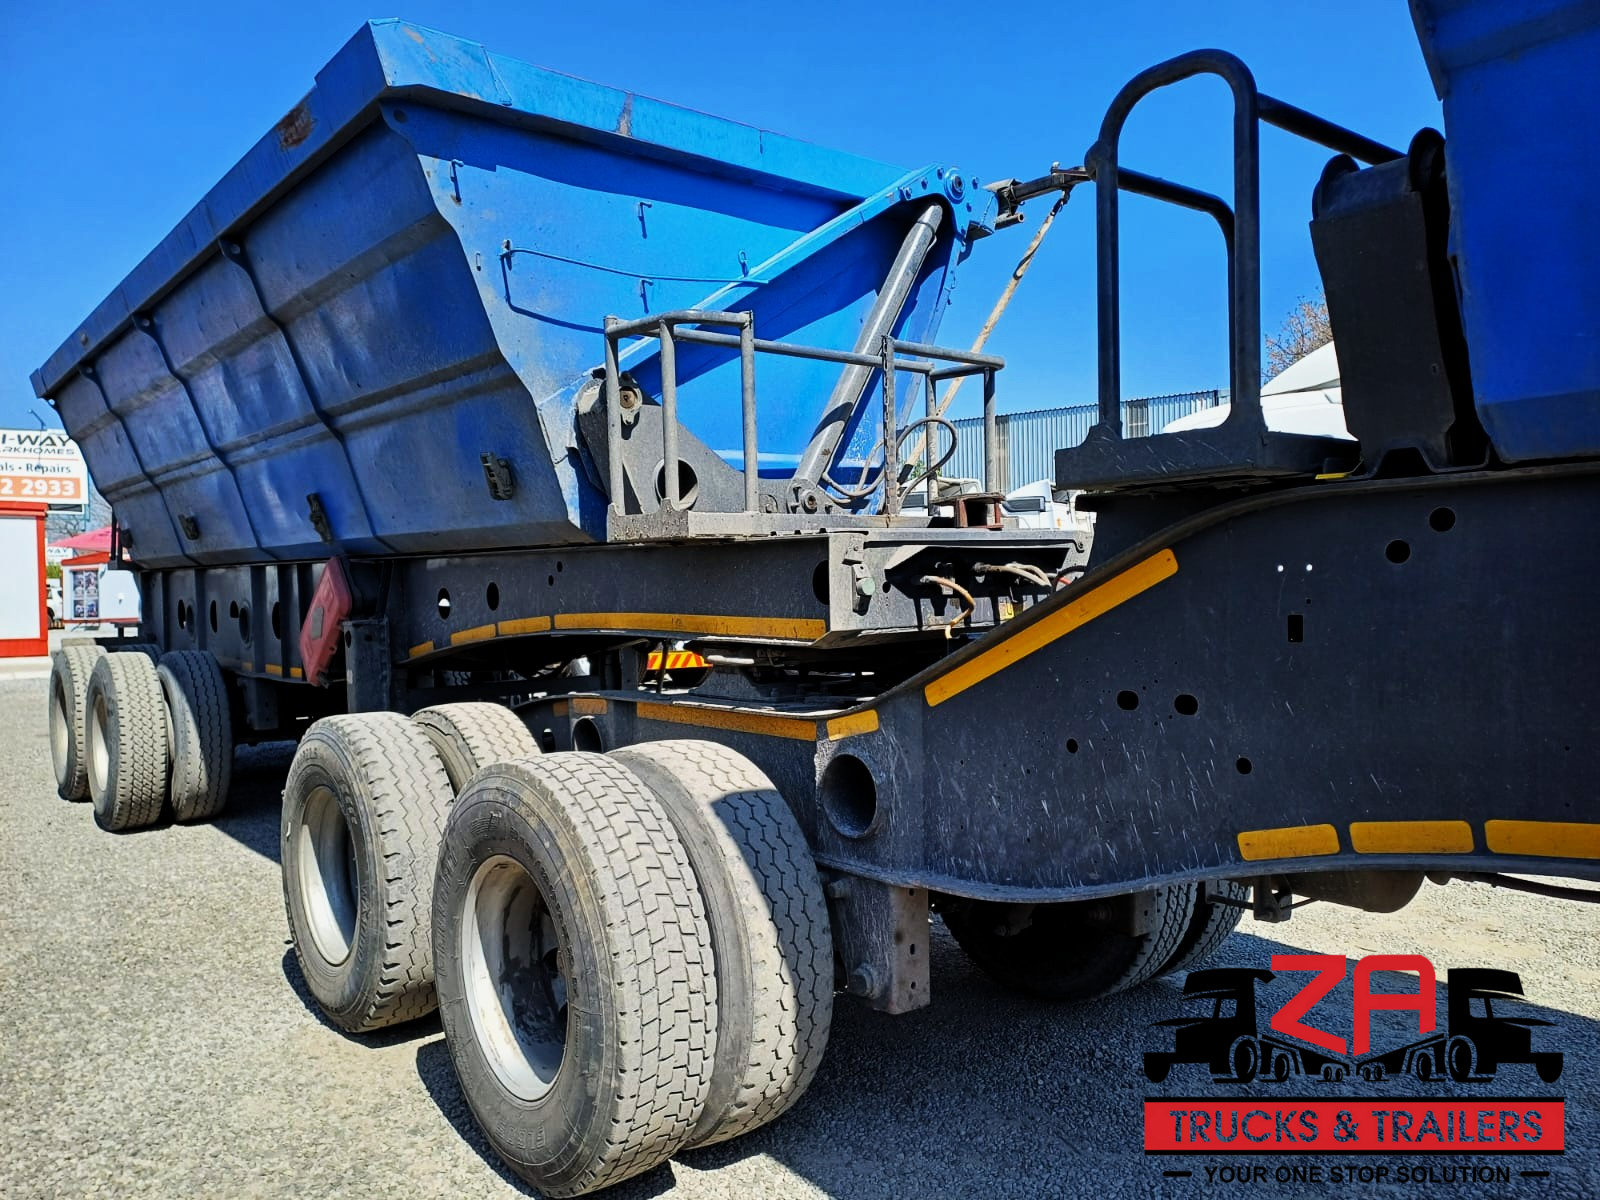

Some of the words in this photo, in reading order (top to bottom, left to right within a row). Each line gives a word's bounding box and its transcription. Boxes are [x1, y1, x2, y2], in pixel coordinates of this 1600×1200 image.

[0, 447, 75, 455] RKHOMES
[25, 463, 71, 475] Repairs
[0, 478, 13, 494] 2
[21, 479, 76, 497] 2933
